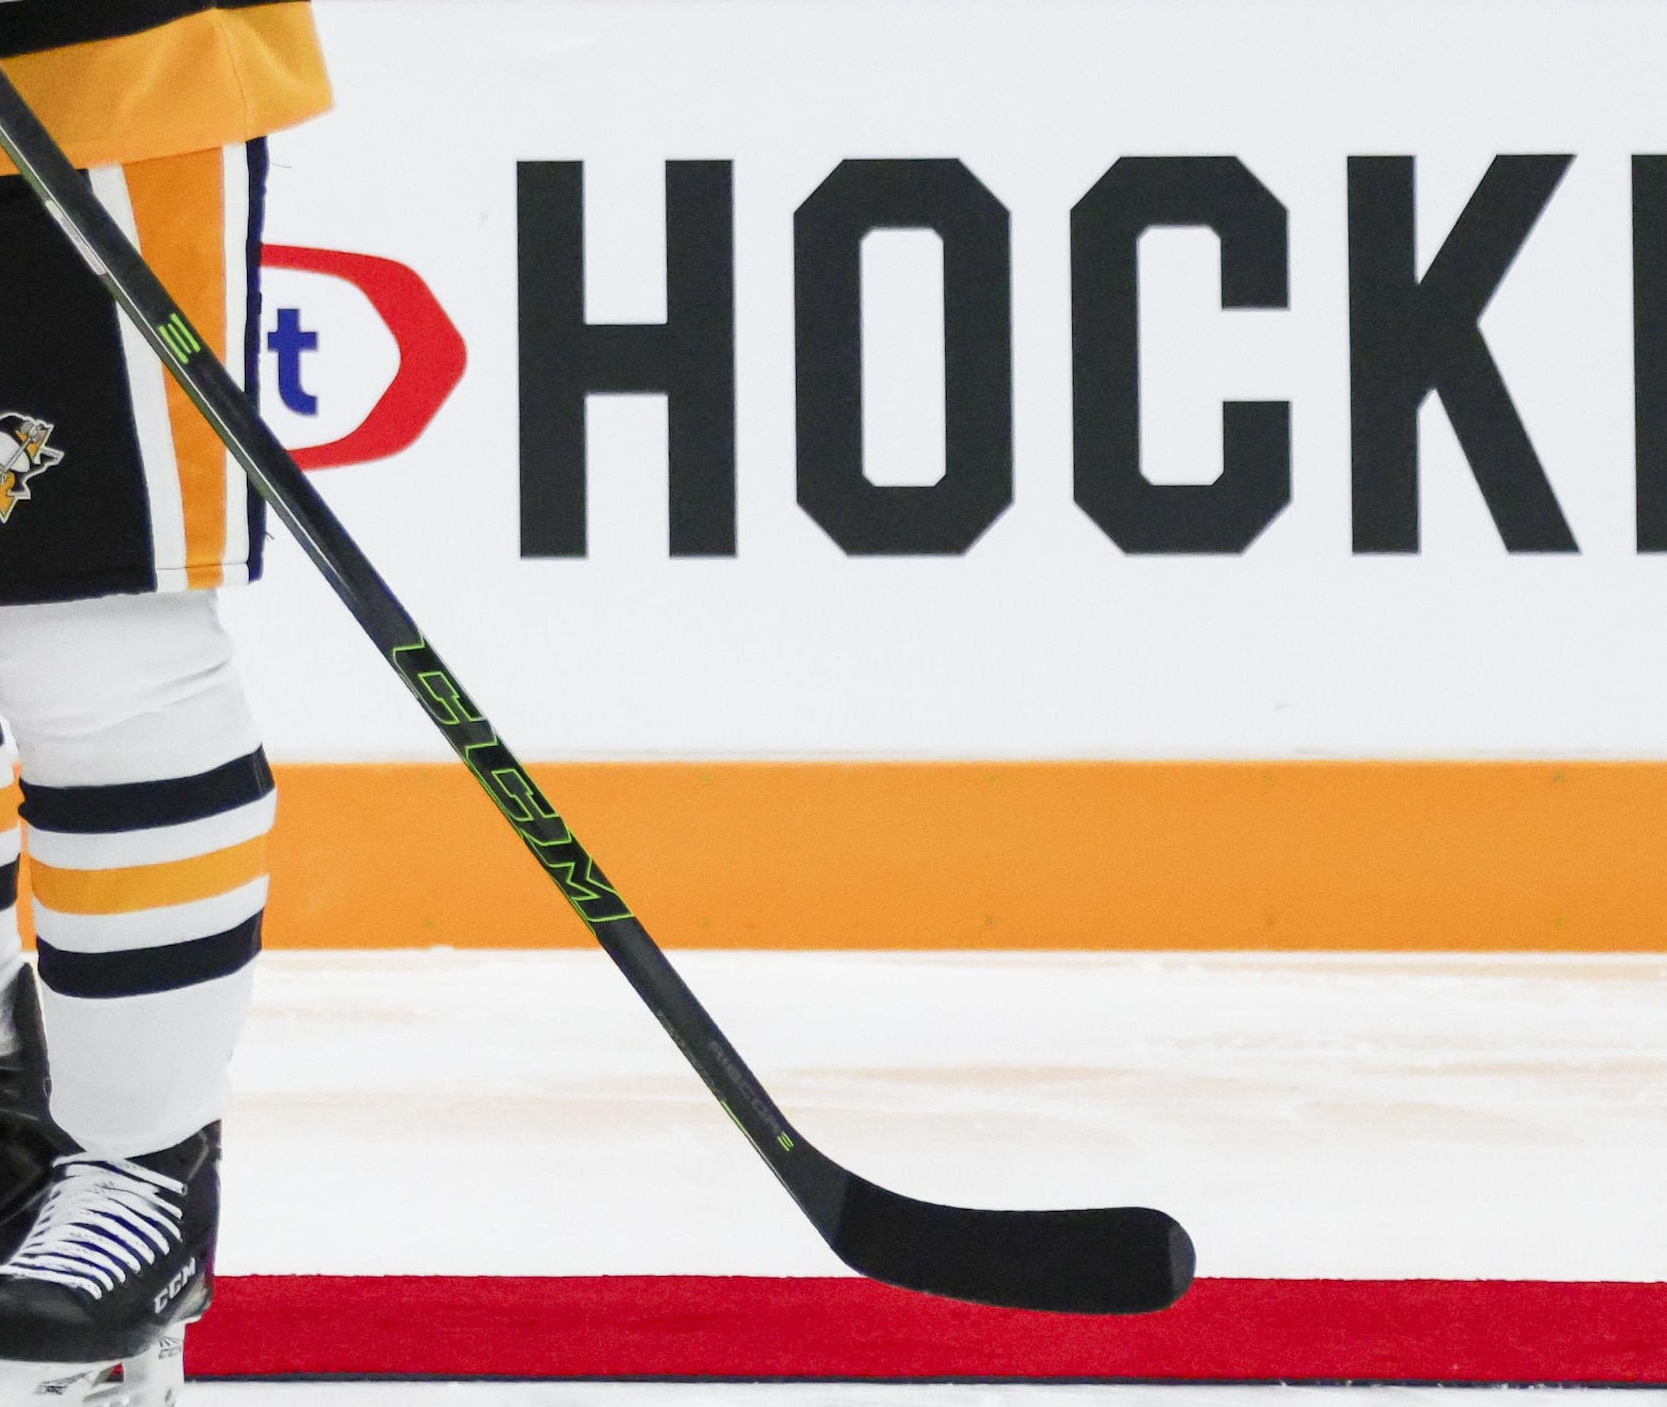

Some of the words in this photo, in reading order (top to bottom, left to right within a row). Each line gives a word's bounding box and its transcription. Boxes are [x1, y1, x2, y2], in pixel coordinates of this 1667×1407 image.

[517, 154, 1667, 557] HOCK
[393, 625, 636, 923] CCM
[153, 1257, 196, 1314] CCM
